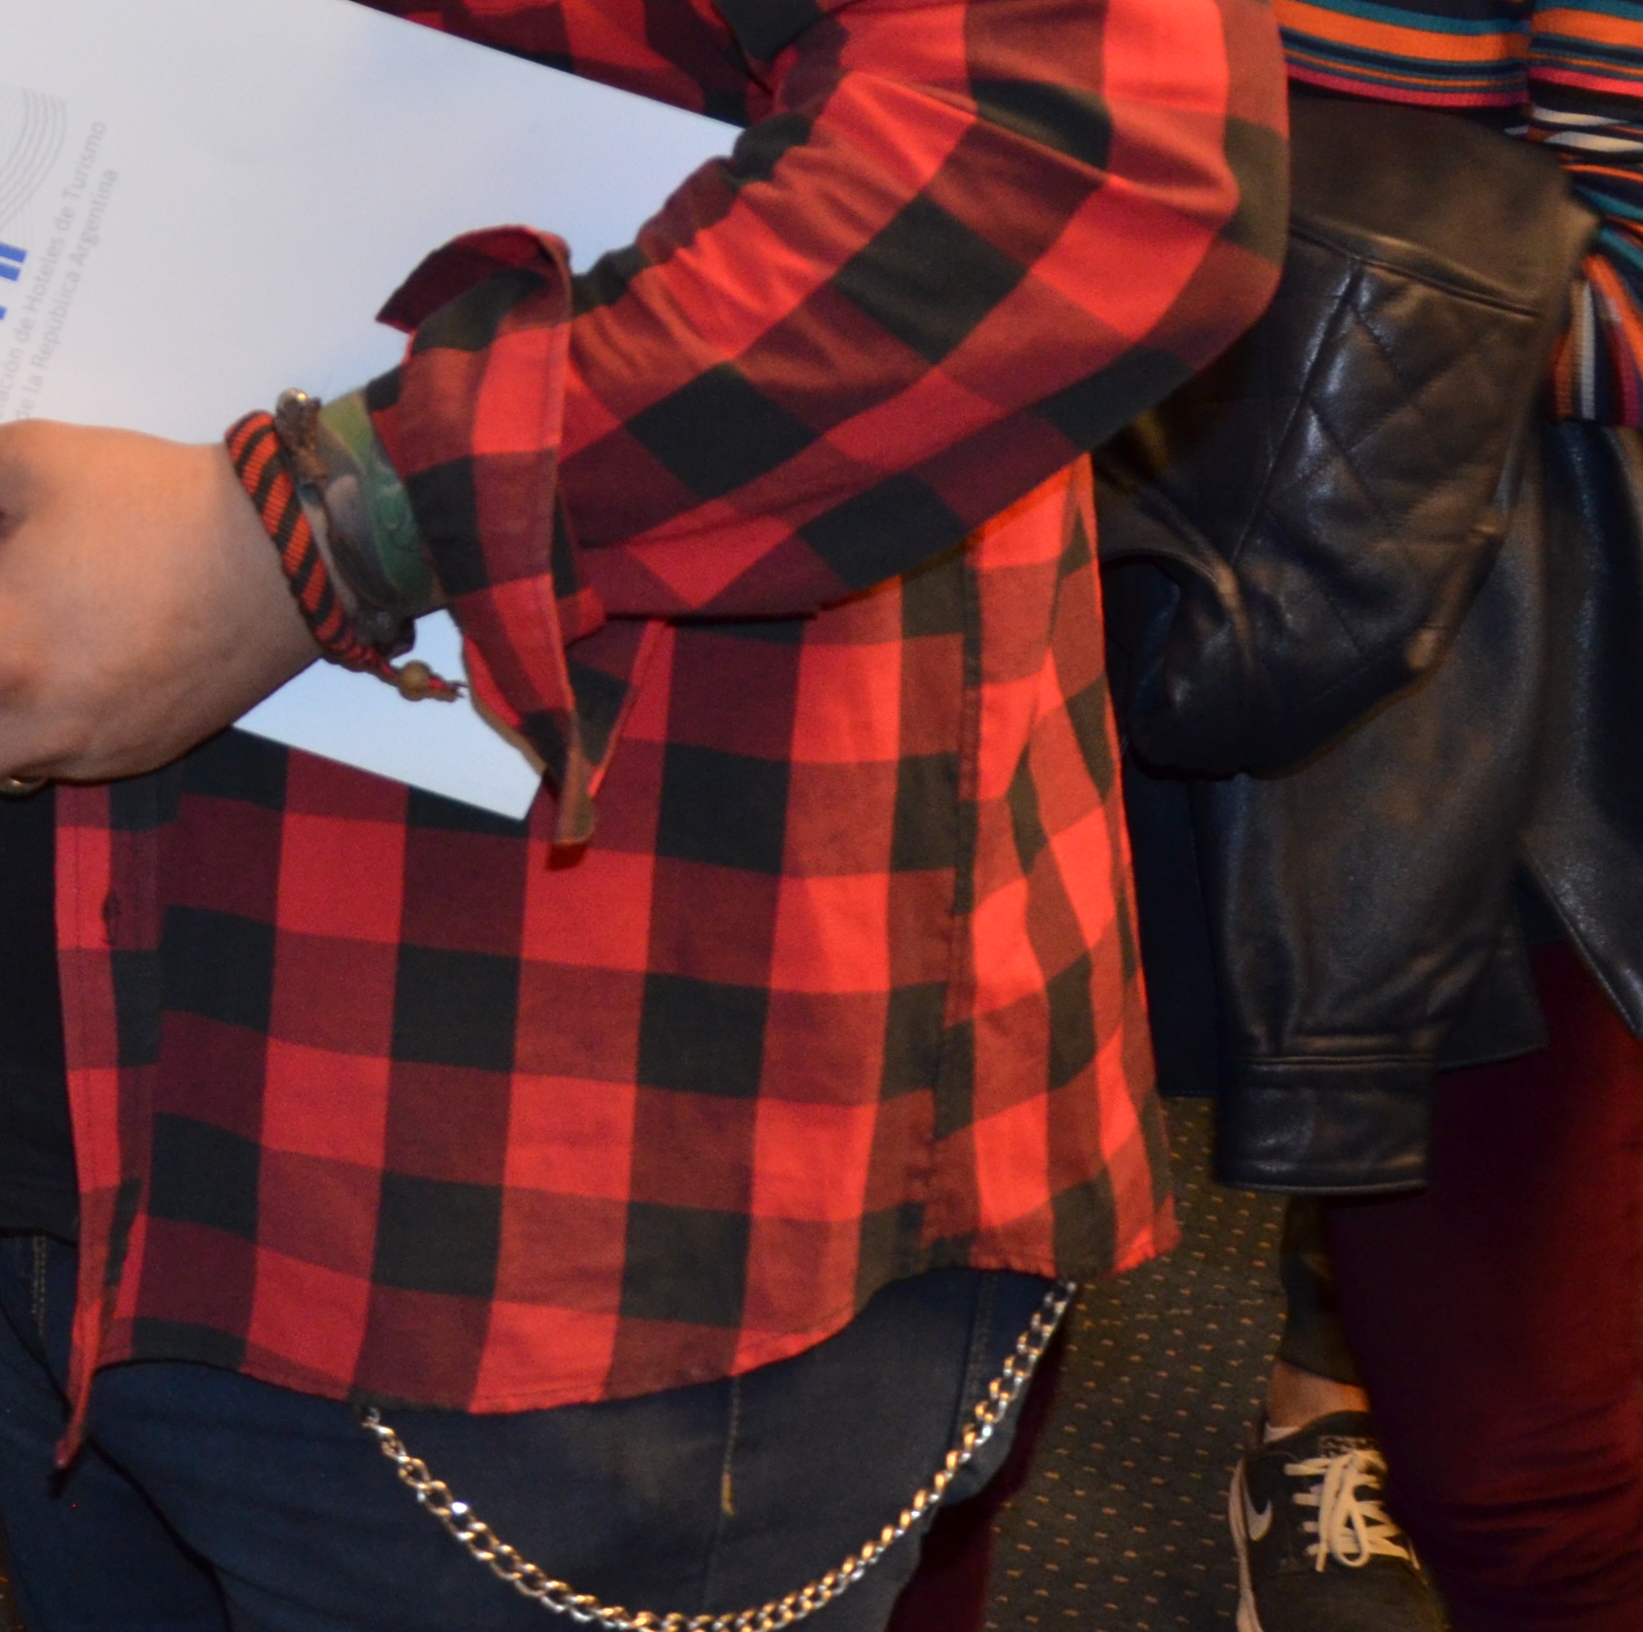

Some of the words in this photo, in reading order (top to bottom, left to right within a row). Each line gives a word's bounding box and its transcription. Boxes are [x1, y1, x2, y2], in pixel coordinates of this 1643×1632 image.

[63, 120, 107, 199] Turismo
[53, 205, 75, 232] de
[70, 169, 119, 266] Argentina
[23, 234, 65, 315] Hoteles
[14, 320, 34, 344] de
[30, 269, 81, 369] República
[21, 372, 43, 394] la
